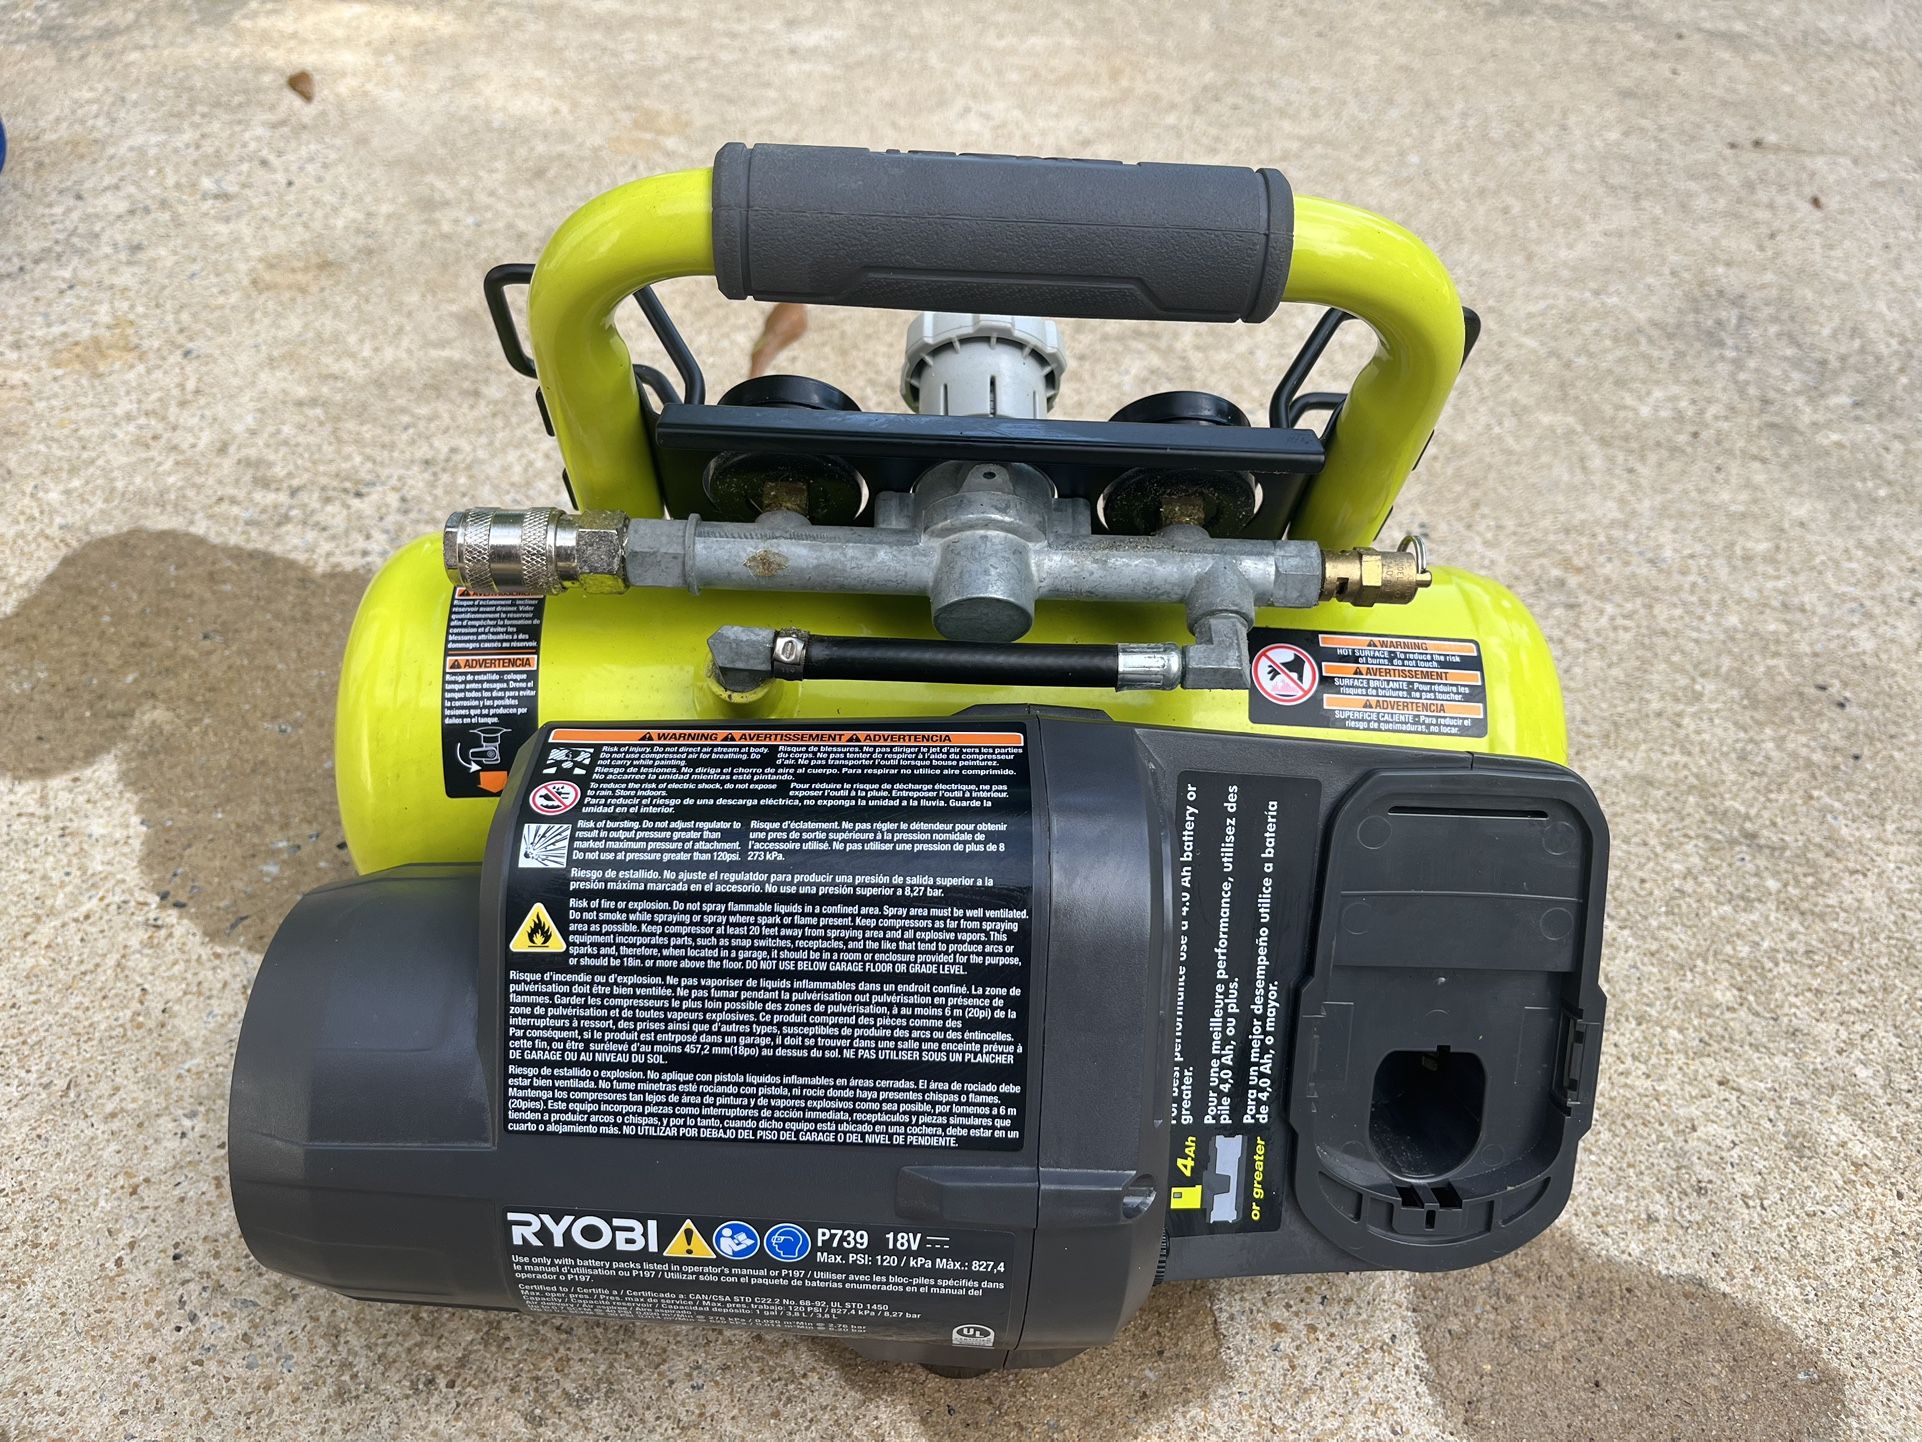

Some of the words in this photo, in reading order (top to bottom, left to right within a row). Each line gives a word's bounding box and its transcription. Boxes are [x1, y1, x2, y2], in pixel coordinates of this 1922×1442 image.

[1355, 650, 1389, 658] SURFACE
[1407, 653, 1432, 661] reduce
[1378, 639, 1428, 651] WARNING
[463, 657, 532, 669] ADVERTENCIA
[1365, 667, 1449, 681] AVERTISSEMENT
[1368, 658, 1391, 666] burns,
[1417, 660, 1440, 668] touch.
[1335, 678, 1368, 687] SURFACE
[1369, 679, 1408, 689] BRÛLANTE
[1414, 683, 1431, 691] Pour
[1432, 684, 1457, 693] réduire
[1375, 699, 1446, 713] ADVERTENCIA
[657, 732, 718, 741] WARNING
[738, 733, 844, 742] AVERTISSEMENT
[863, 734, 952, 743] ADVERTENCIA
[1187, 784, 1196, 800] or
[1224, 786, 1238, 812] des
[577, 820, 595, 828] Risk
[596, 820, 605, 828] of
[606, 820, 641, 830] bursting.
[642, 820, 653, 828] Do
[655, 820, 668, 828] not
[669, 820, 694, 830] adjust
[695, 821, 731, 830] regulator
[732, 821, 741, 829] to
[1180, 806, 1198, 861] battery
[1261, 802, 1277, 857] batería
[1221, 818, 1235, 871] utilisez
[748, 852, 765, 860] 273
[766, 852, 785, 861] kPa.
[1264, 863, 1273, 872] a
[1181, 867, 1191, 887] Ah
[570, 881, 605, 892] presión
[607, 882, 645, 891] máxima
[647, 882, 688, 892] marcada
[704, 883, 713, 892] el
[715, 883, 763, 893] accesorio.
[765, 884, 778, 893] No
[780, 886, 797, 894] use
[819, 885, 854, 897] presión
[856, 886, 895, 898] superior
[905, 887, 925, 898] 8,27
[927, 888, 944, 897] bar.
[1258, 878, 1272, 922] utilice
[1214, 877, 1234, 978] performance,
[569, 958, 578, 966] or
[580, 957, 608, 966] should
[610, 957, 621, 966] be
[623, 958, 643, 967] 18in.
[680, 959, 705, 968] above
[707, 959, 721, 968] the
[723, 959, 744, 969] floor.
[746, 960, 758, 969] DO
[760, 960, 777, 969] NOT
[779, 961, 795, 970] USE
[797, 961, 828, 971] BELOW
[829, 962, 864, 972] GARAGE
[866, 963, 893, 972] FLOOR
[895, 964, 907, 973] OR
[909, 964, 938, 973] GRADE
[940, 965, 967, 974] LEVEL.
[1250, 928, 1269, 1014] desempeño
[1224, 978, 1239, 1012] plus.
[1266, 981, 1279, 1031] mayor.
[1210, 984, 1224, 1054] meilleure
[1226, 1018, 1236, 1036] ou
[1249, 1019, 1264, 1061] mejor
[1265, 1036, 1274, 1045] o
[510, 1050, 522, 1059] DE
[524, 1051, 562, 1061] GARAGE
[565, 1052, 578, 1061] OU
[580, 1053, 593, 1062] AU
[595, 1053, 629, 1063] NIVEAU
[632, 1054, 645, 1063] DU
[647, 1055, 668, 1064] SOL.
[1221, 1041, 1236, 1065] Ah,
[1260, 1050, 1275, 1074] Ah,
[1210, 1059, 1220, 1086] une
[1220, 1070, 1233, 1092] 4,0
[1249, 1067, 1258, 1084] un
[1181, 1067, 1193, 1124] greater.
[1258, 1078, 1272, 1101] 4,0
[1204, 1090, 1217, 1123] Pour
[1217, 1097, 1232, 1123] pile
[1243, 1090, 1256, 1123] Para
[1256, 1105, 1268, 1123] de
[1176, 1136, 1197, 1177] 4Ah
[1253, 1137, 1265, 1198] greater
[1252, 1202, 1260, 1220] or
[506, 1212, 659, 1253] RYOBI
[817, 1228, 869, 1249] P739
[886, 1231, 922, 1251] 18V
[512, 1255, 530, 1263] Use
[532, 1256, 552, 1266] only
[554, 1257, 575, 1266] with
[577, 1258, 610, 1270] battery
[613, 1260, 641, 1271] packs
[644, 1262, 669, 1271] listed
[672, 1263, 680, 1271] in
[682, 1264, 730, 1276] operator's
[732, 1266, 767, 1276] manual
[782, 1269, 805, 1277] P197
[814, 1270, 847, 1280] Utiliser
[873, 1274, 887, 1282] les
[889, 1275, 935, 1287] bloc-piles
[937, 1277, 979, 1289] spécifiés
[981, 1280, 1005, 1288] dans
[817, 1252, 846, 1264] Max.
[849, 1253, 872, 1265] PSI:
[876, 1255, 898, 1266] 120
[910, 1257, 932, 1268] kPa
[972, 1260, 1005, 1274] 827,4
[515, 1271, 557, 1282] operador
[568, 1273, 594, 1282] P197.
[963, 1327, 985, 1338] UL
